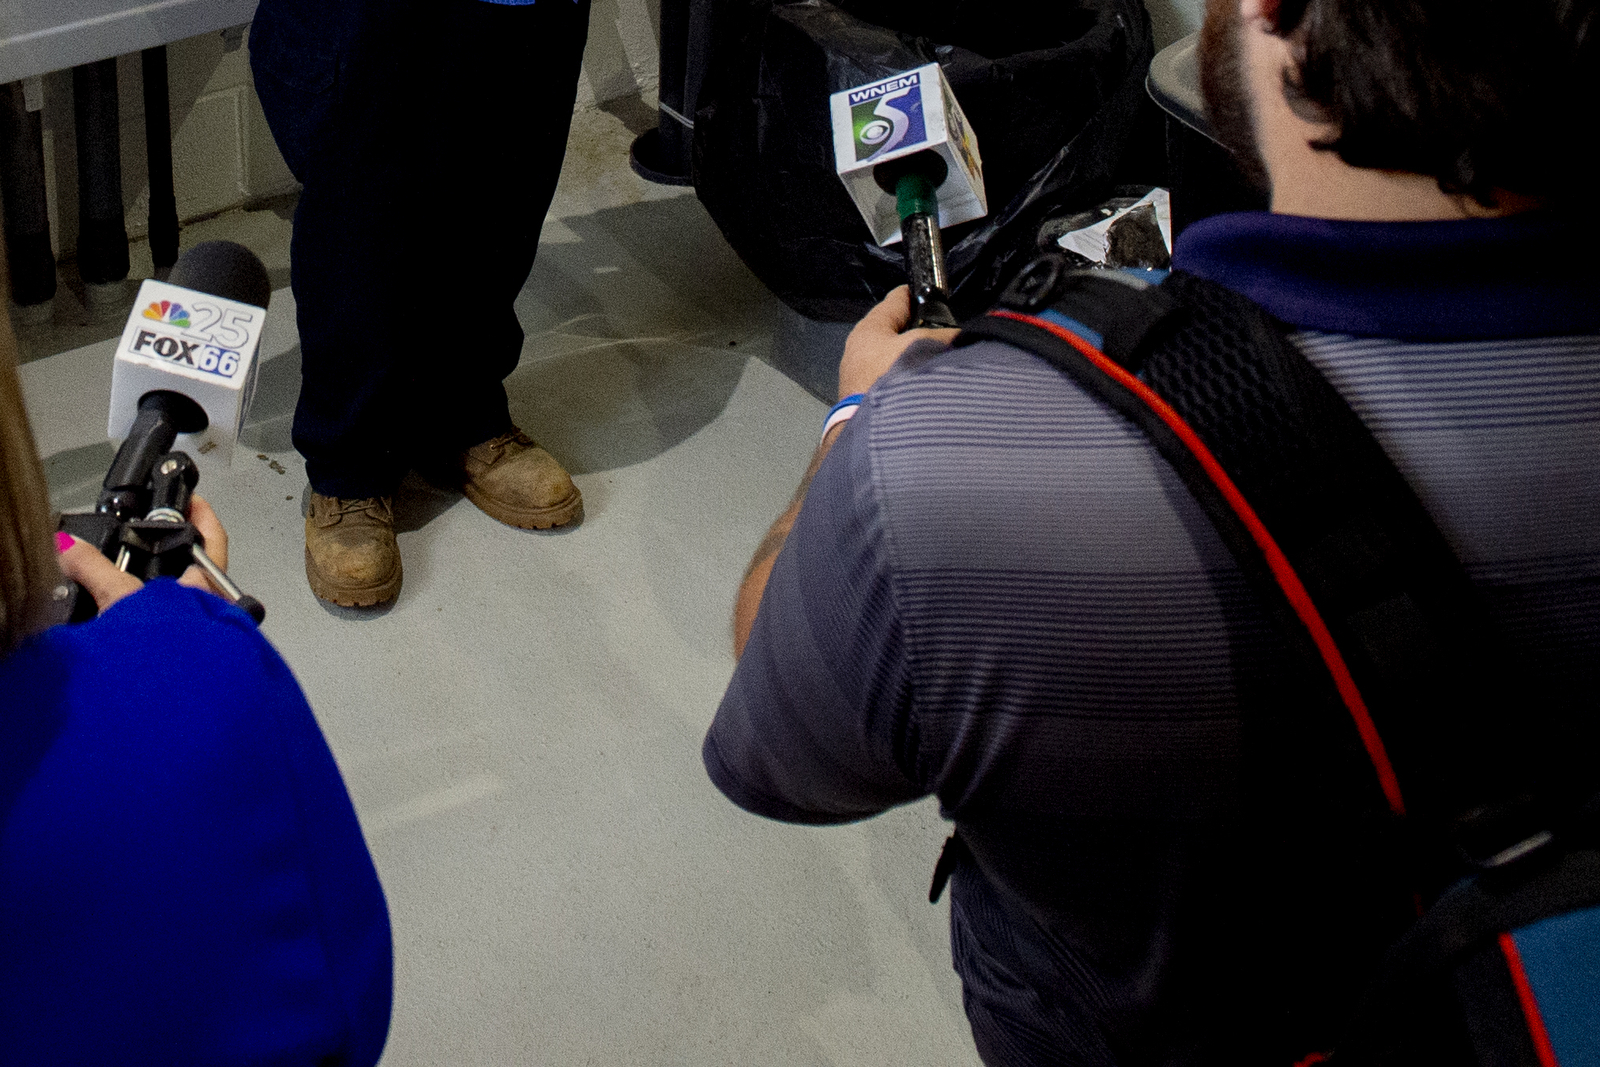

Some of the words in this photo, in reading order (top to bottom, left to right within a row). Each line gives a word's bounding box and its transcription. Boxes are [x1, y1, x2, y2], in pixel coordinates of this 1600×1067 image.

[850, 74, 919, 103] WNEM
[180, 300, 253, 349] 25
[134, 330, 199, 365] FOX
[200, 345, 240, 377] 66
